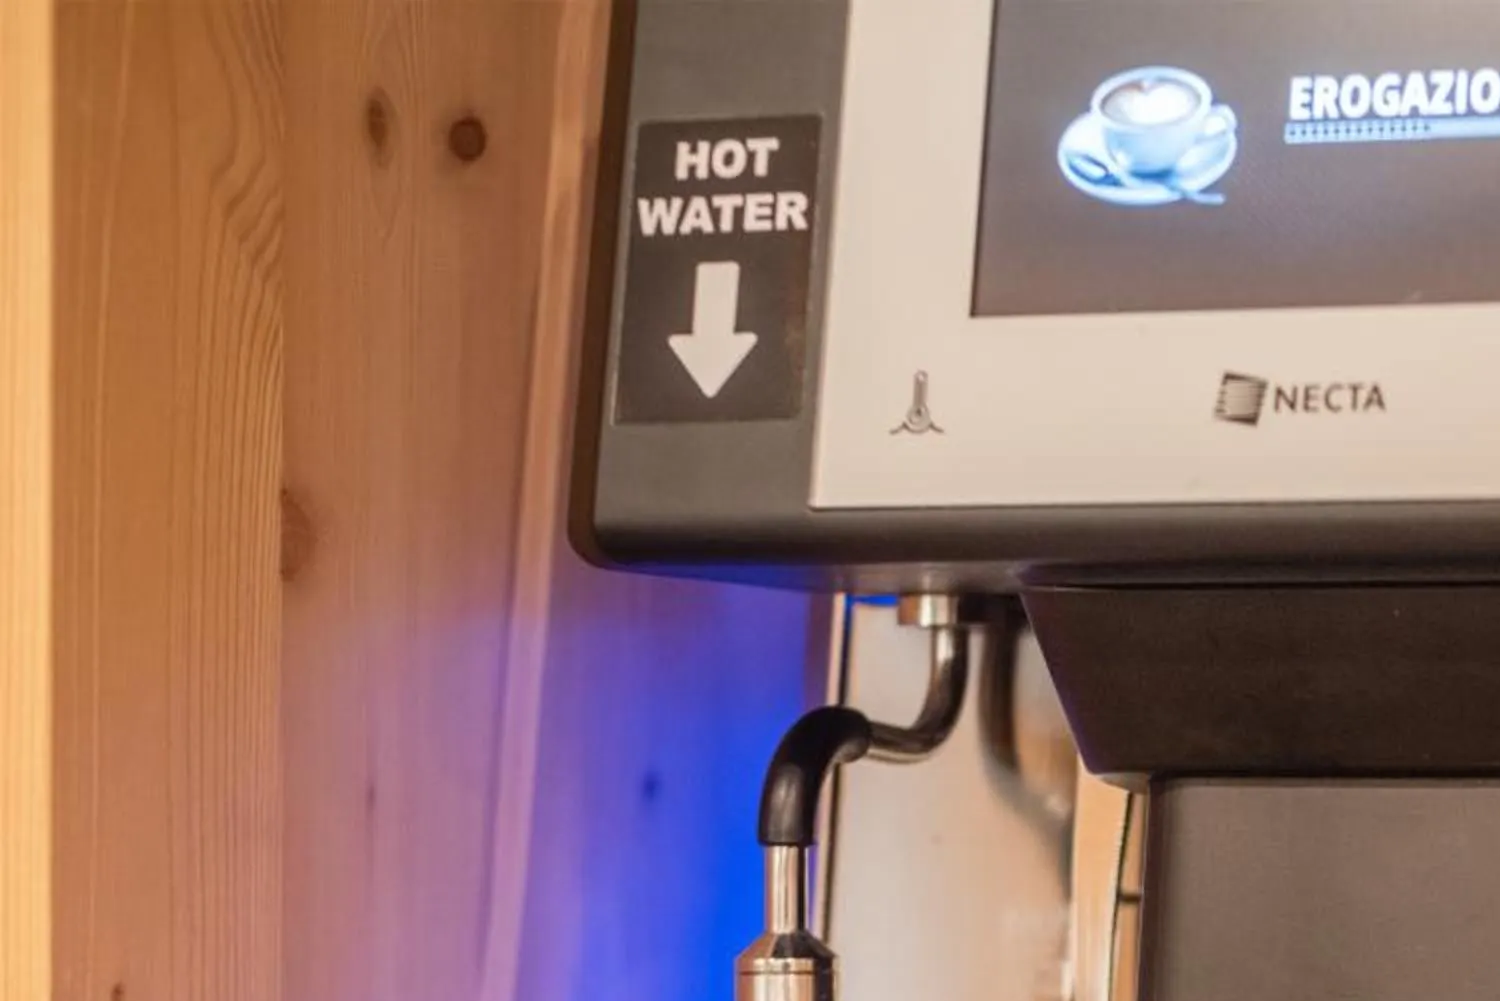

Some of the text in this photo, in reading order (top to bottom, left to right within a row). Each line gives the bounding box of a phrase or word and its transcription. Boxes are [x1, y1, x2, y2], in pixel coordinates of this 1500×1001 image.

[674, 136, 780, 181] HOT
[636, 190, 810, 237] WATER
[1272, 382, 1386, 413] NECTA
